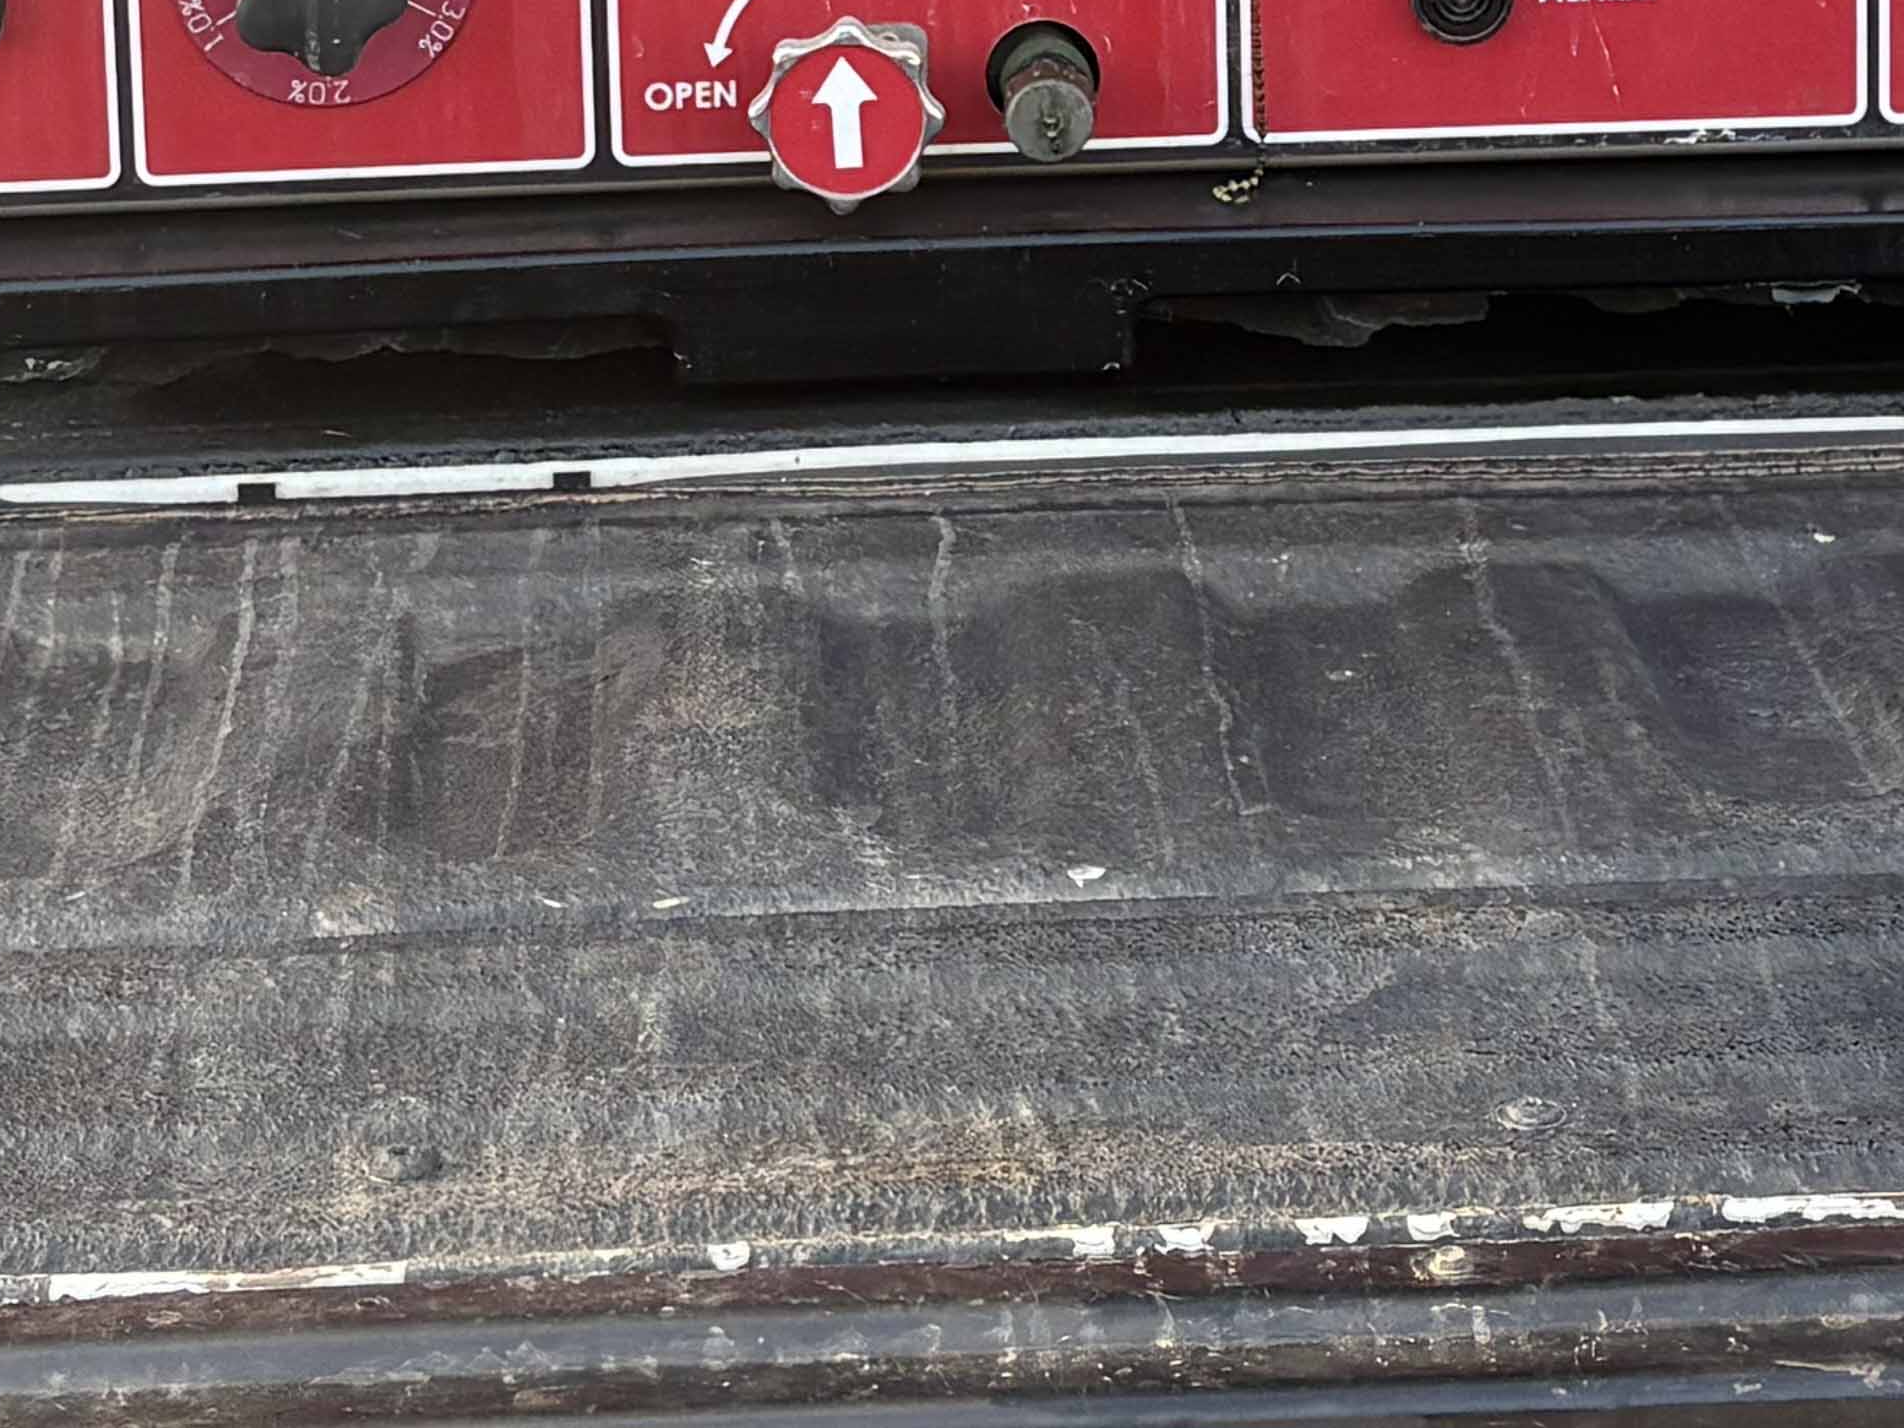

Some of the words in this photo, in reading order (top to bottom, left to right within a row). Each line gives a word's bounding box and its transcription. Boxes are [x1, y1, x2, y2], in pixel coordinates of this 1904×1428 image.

[418, 0, 466, 58] 3.0%
[287, 78, 352, 105] 2.0%
[644, 80, 737, 112] OPEN
